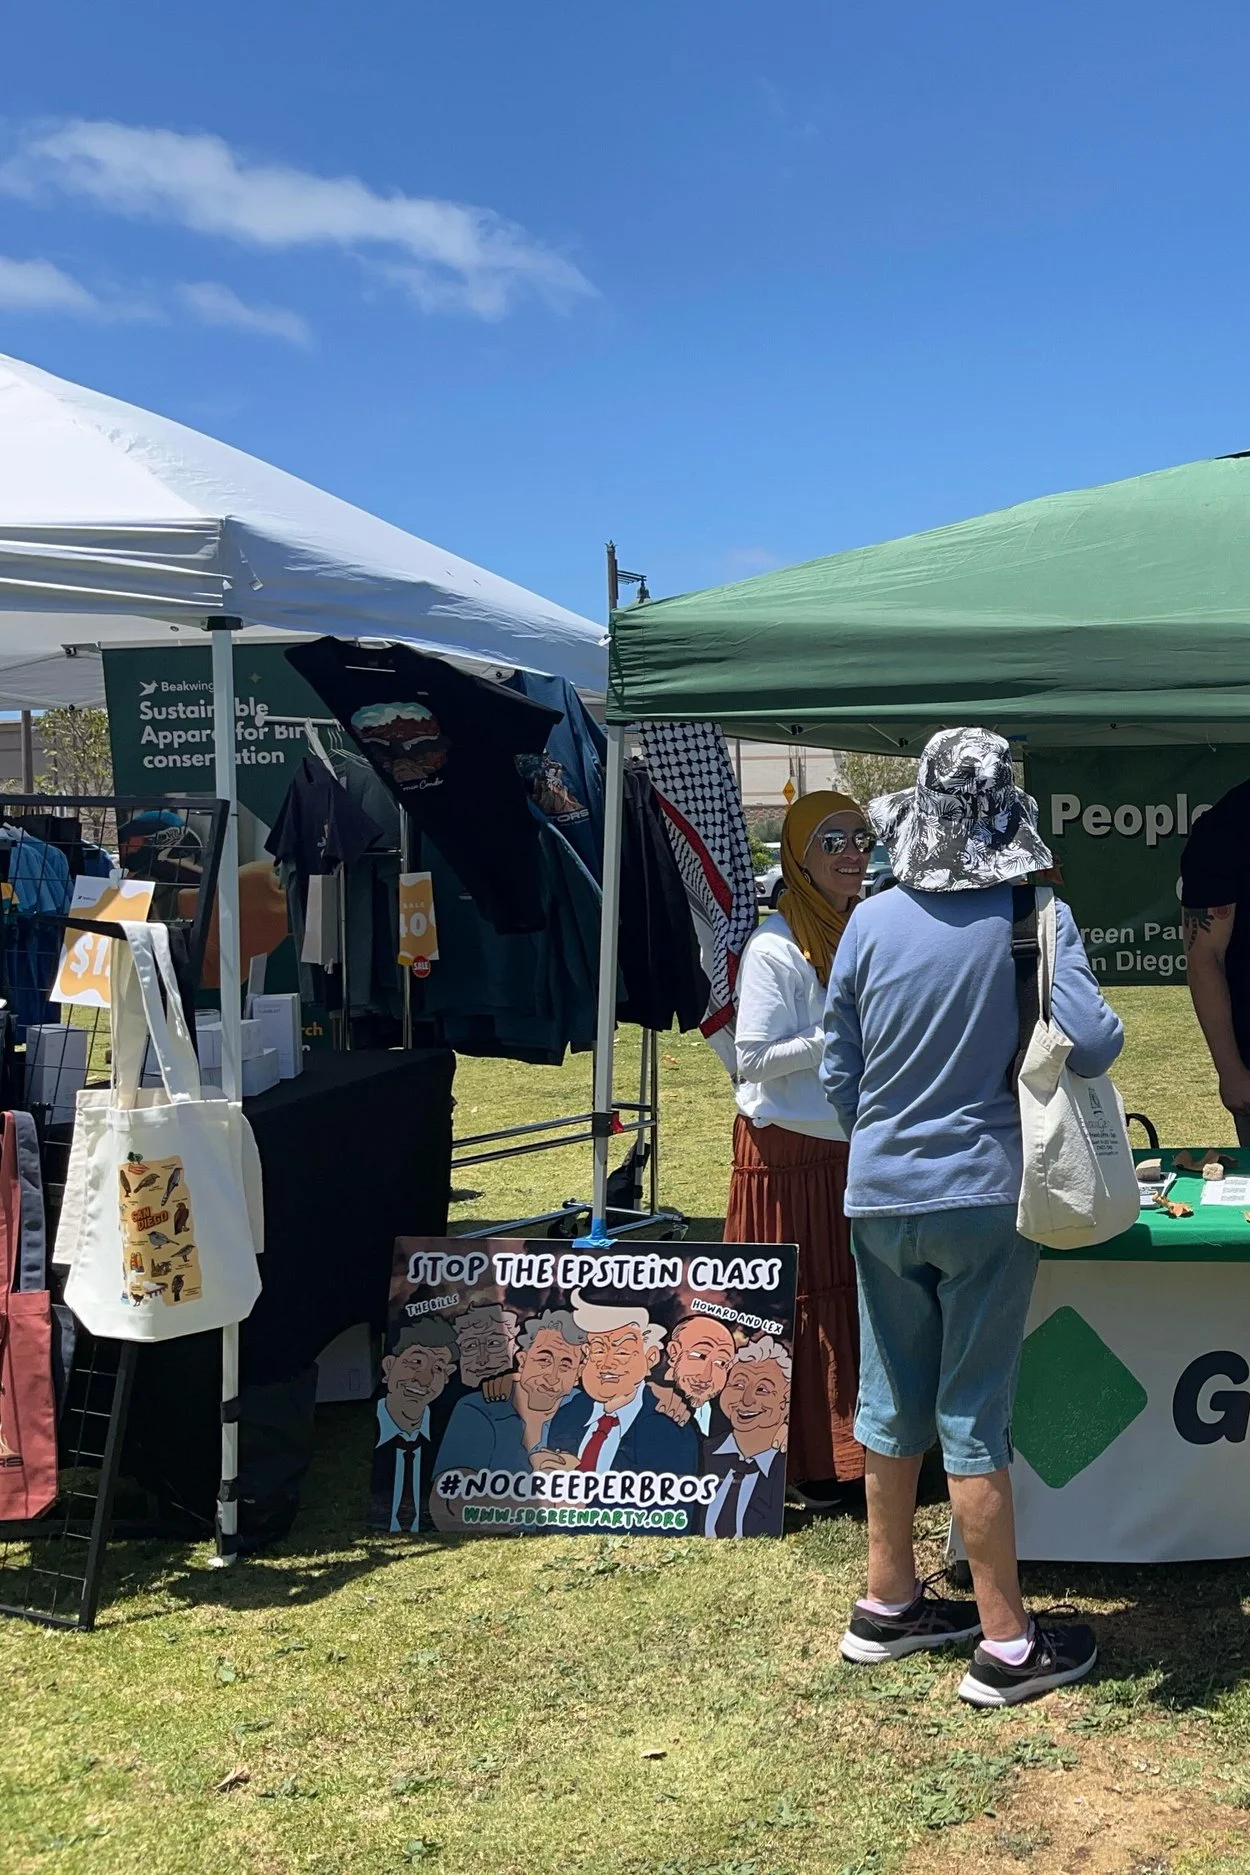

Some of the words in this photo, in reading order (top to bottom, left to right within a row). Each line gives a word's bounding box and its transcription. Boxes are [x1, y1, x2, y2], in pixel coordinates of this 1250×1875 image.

[235, 721, 269, 741] for
[143, 746, 285, 769] conseration
[1080, 925, 1135, 945] reen
[413, 961, 429, 970] SALE
[131, 1206, 152, 1222] SAN
[137, 1210, 169, 1231] DIEGO
[410, 1253, 487, 1284] STOP
[496, 1256, 552, 1287] THE
[690, 1258, 783, 1291] CLASS
[406, 1302, 428, 1317] THE
[692, 1299, 738, 1322] HOWARD
[738, 1313, 761, 1328] AND
[761, 1318, 784, 1335] LEX
[439, 1472, 719, 1503] #NOCREEPERBROS
[463, 1506, 688, 1529] WWW.SDGREENPARTY.ORG
